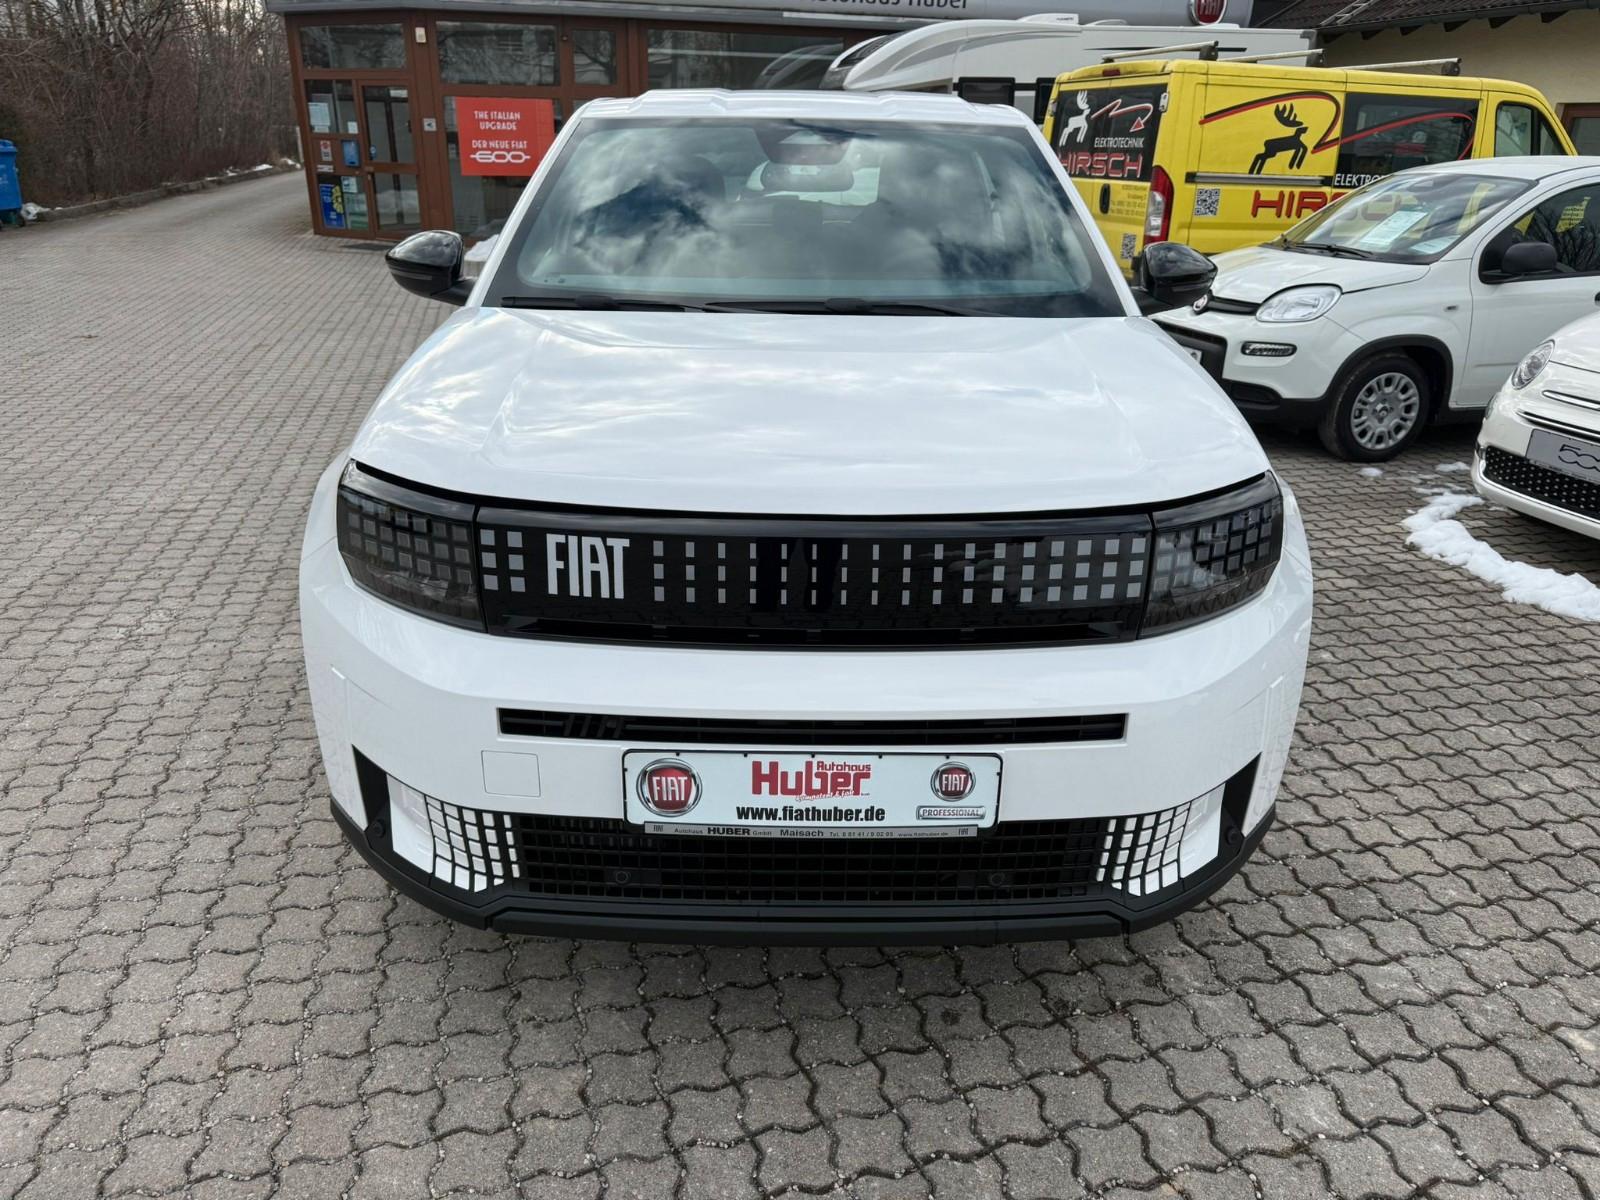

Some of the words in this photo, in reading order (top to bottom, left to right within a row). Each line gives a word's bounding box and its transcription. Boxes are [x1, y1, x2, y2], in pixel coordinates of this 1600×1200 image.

[473, 110, 489, 119] THE
[490, 111, 521, 120] ITALIAN
[479, 121, 518, 131] UPGRADE
[471, 139, 487, 148] DER
[488, 140, 510, 149] NEUE
[511, 140, 528, 149] FIAT
[1094, 136, 1145, 149] ELEKTROTECHNIK
[1057, 151, 1144, 179] HIRSCH
[545, 532, 630, 599] FIAT
[816, 760, 872, 772] Autohaus
[751, 760, 872, 797] Huber
[942, 774, 967, 791] FIAT
[652, 776, 688, 801] FIAT
[736, 805, 886, 822] www.fiathuber.de
[922, 808, 981, 817] PROFESSIONAL
[707, 826, 750, 836] HUBER
[780, 828, 824, 837] Maisach
